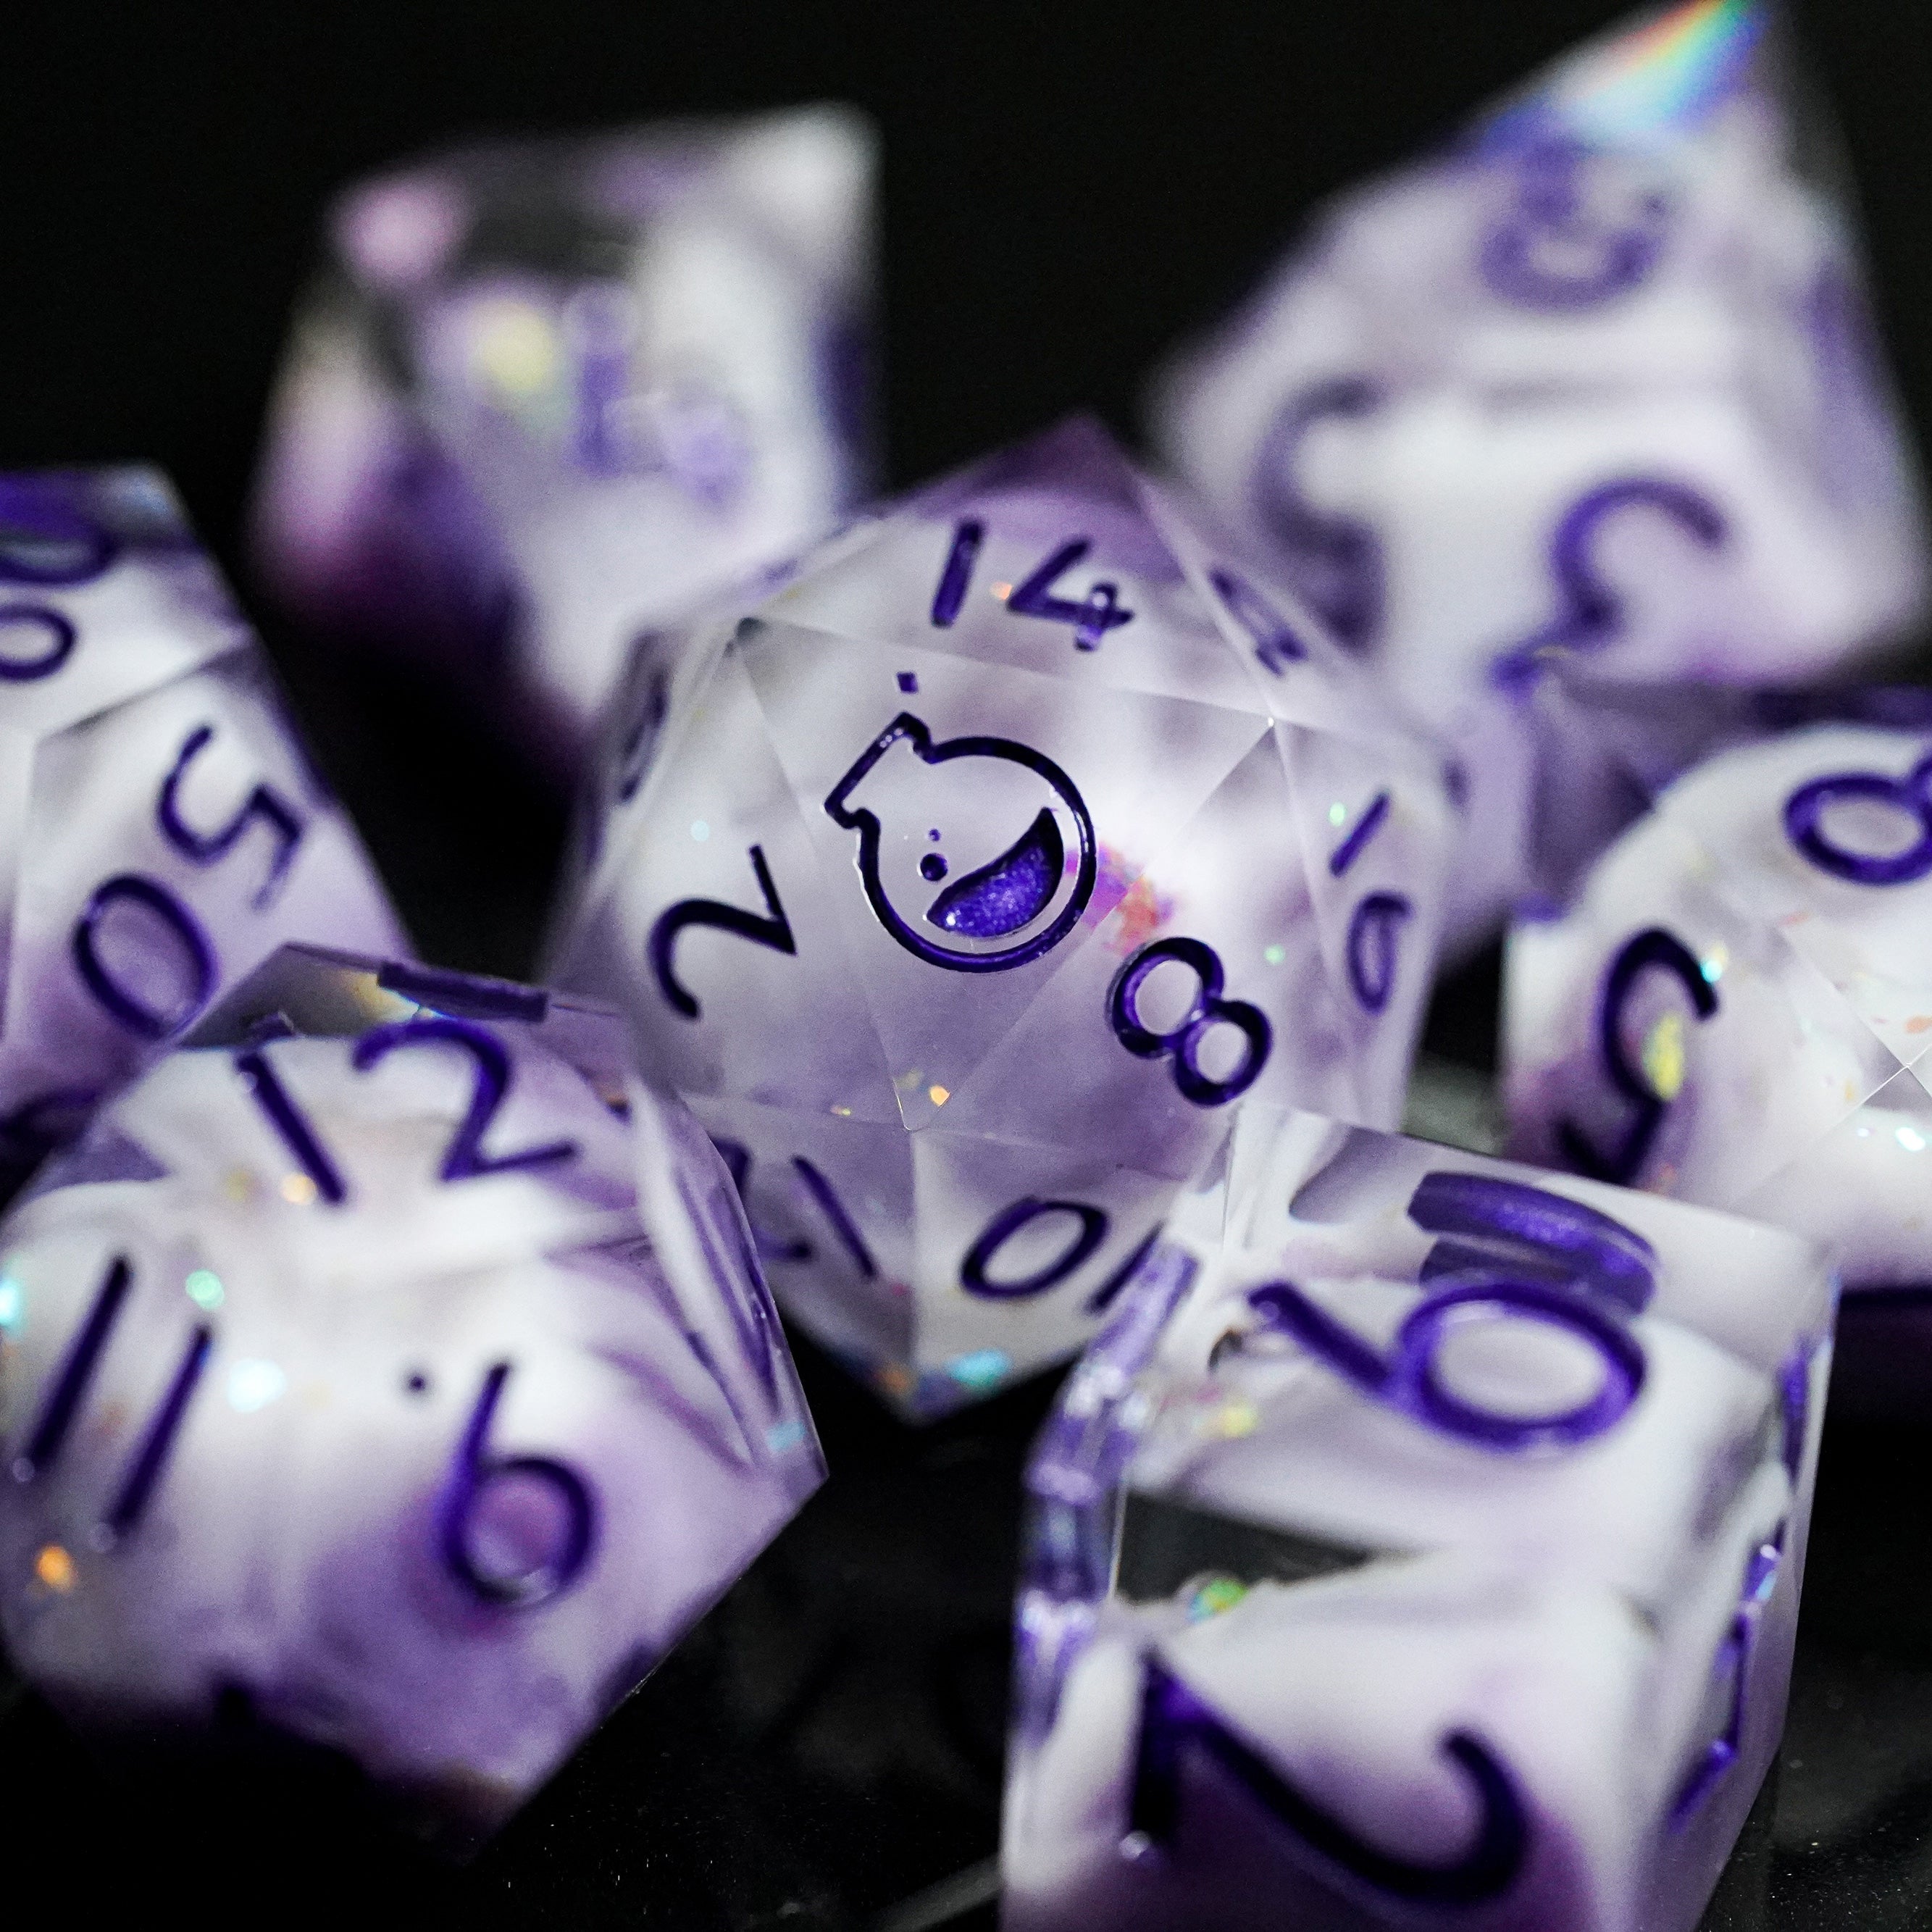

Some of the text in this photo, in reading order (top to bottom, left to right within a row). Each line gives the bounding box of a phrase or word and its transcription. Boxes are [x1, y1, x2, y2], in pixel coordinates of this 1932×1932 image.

[931, 519, 1134, 651] 14
[647, 842, 797, 1021] 2
[1108, 934, 1273, 1107] 8
[235, 1014, 581, 1208] 12
[13, 1255, 214, 1539] 11
[1130, 1644, 1534, 1909] 2
